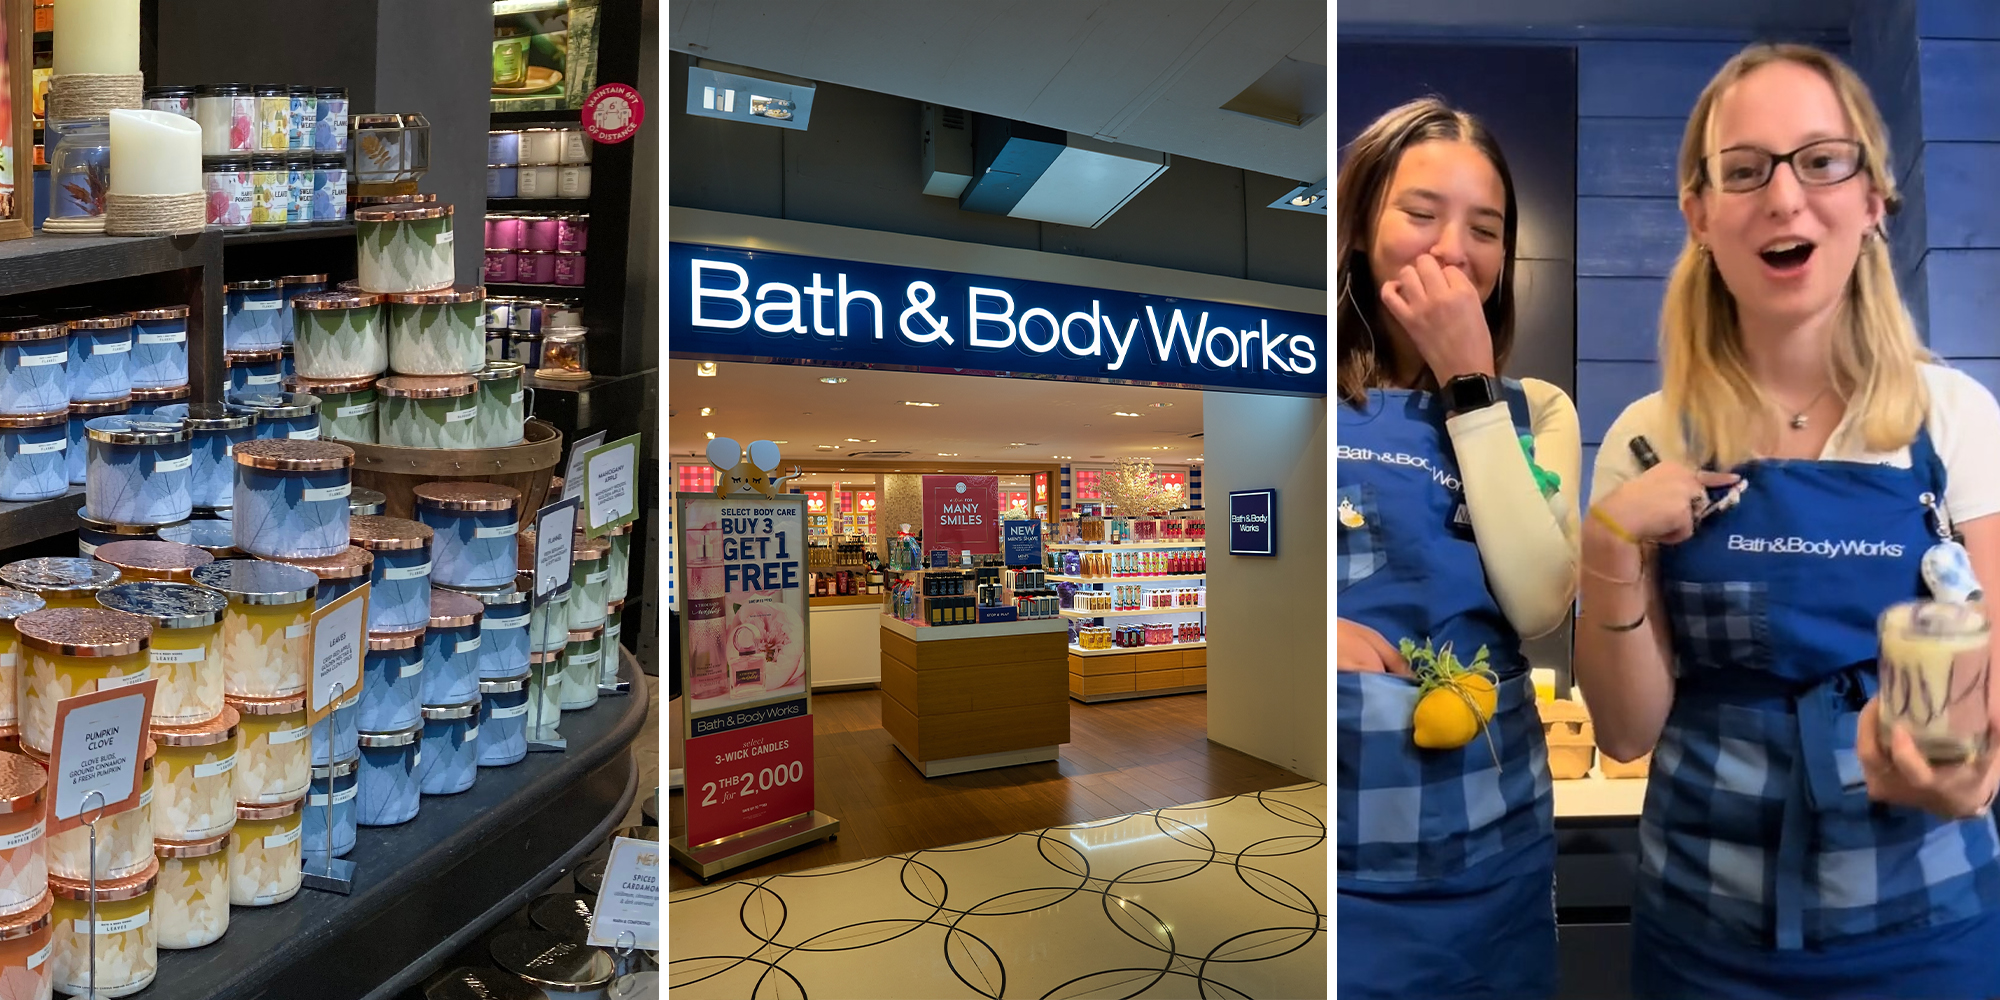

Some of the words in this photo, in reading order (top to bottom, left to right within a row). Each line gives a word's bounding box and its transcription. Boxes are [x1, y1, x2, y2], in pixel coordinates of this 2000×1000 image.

[588, 87, 625, 108] MAINTAIN
[625, 92, 639, 104] 6FT
[589, 125, 599, 134] OF
[599, 122, 637, 140] DISTANCE
[690, 258, 884, 339] Bath
[900, 280, 955, 346] &
[969, 286, 1139, 371] Body
[1145, 304, 1317, 375] Works
[598, 464, 625, 479] MAHOGANY
[1337, 445, 1380, 461] Bath
[1381, 453, 1396, 464] &
[1432, 465, 1465, 492] Wor
[605, 473, 618, 483] APPLE
[721, 508, 751, 516] SELECT
[753, 508, 774, 516] BODY
[776, 508, 796, 516] CARE
[943, 503, 979, 514] MANY
[721, 518, 758, 535] BUY
[762, 518, 773, 534] 3
[940, 515, 983, 525] SMILES
[1231, 514, 1245, 523] Bath
[1245, 514, 1251, 522] &
[1251, 513, 1268, 524] Body
[1010, 526, 1035, 536] NEW
[1239, 524, 1260, 532] Works
[723, 537, 771, 561] GET
[774, 531, 789, 559] 1
[1727, 534, 1773, 552] Bath
[1787, 536, 1840, 559] Body
[1840, 538, 1903, 557] Works
[724, 561, 799, 593] FREE
[329, 631, 347, 648] LEAVES
[697, 718, 725, 732] Bath
[726, 716, 735, 727] &
[736, 711, 766, 725] Body
[766, 705, 799, 718] Works
[85, 726, 120, 742] PUMPKIN
[88, 736, 114, 751] CLOVE
[742, 737, 764, 749] select
[715, 748, 749, 765] 3-WICK
[751, 739, 789, 756] CANDLES
[69, 766, 95, 778] GROUND
[95, 756, 126, 771] CINNAMON
[81, 757, 100, 768] CLOVE
[78, 772, 96, 783] FRESH
[96, 765, 122, 778] PUMPKIN
[718, 775, 740, 789] THB
[740, 760, 803, 797] 2,000
[701, 782, 718, 808] 2
[721, 791, 736, 805] for
[633, 874, 656, 884] SPICED
